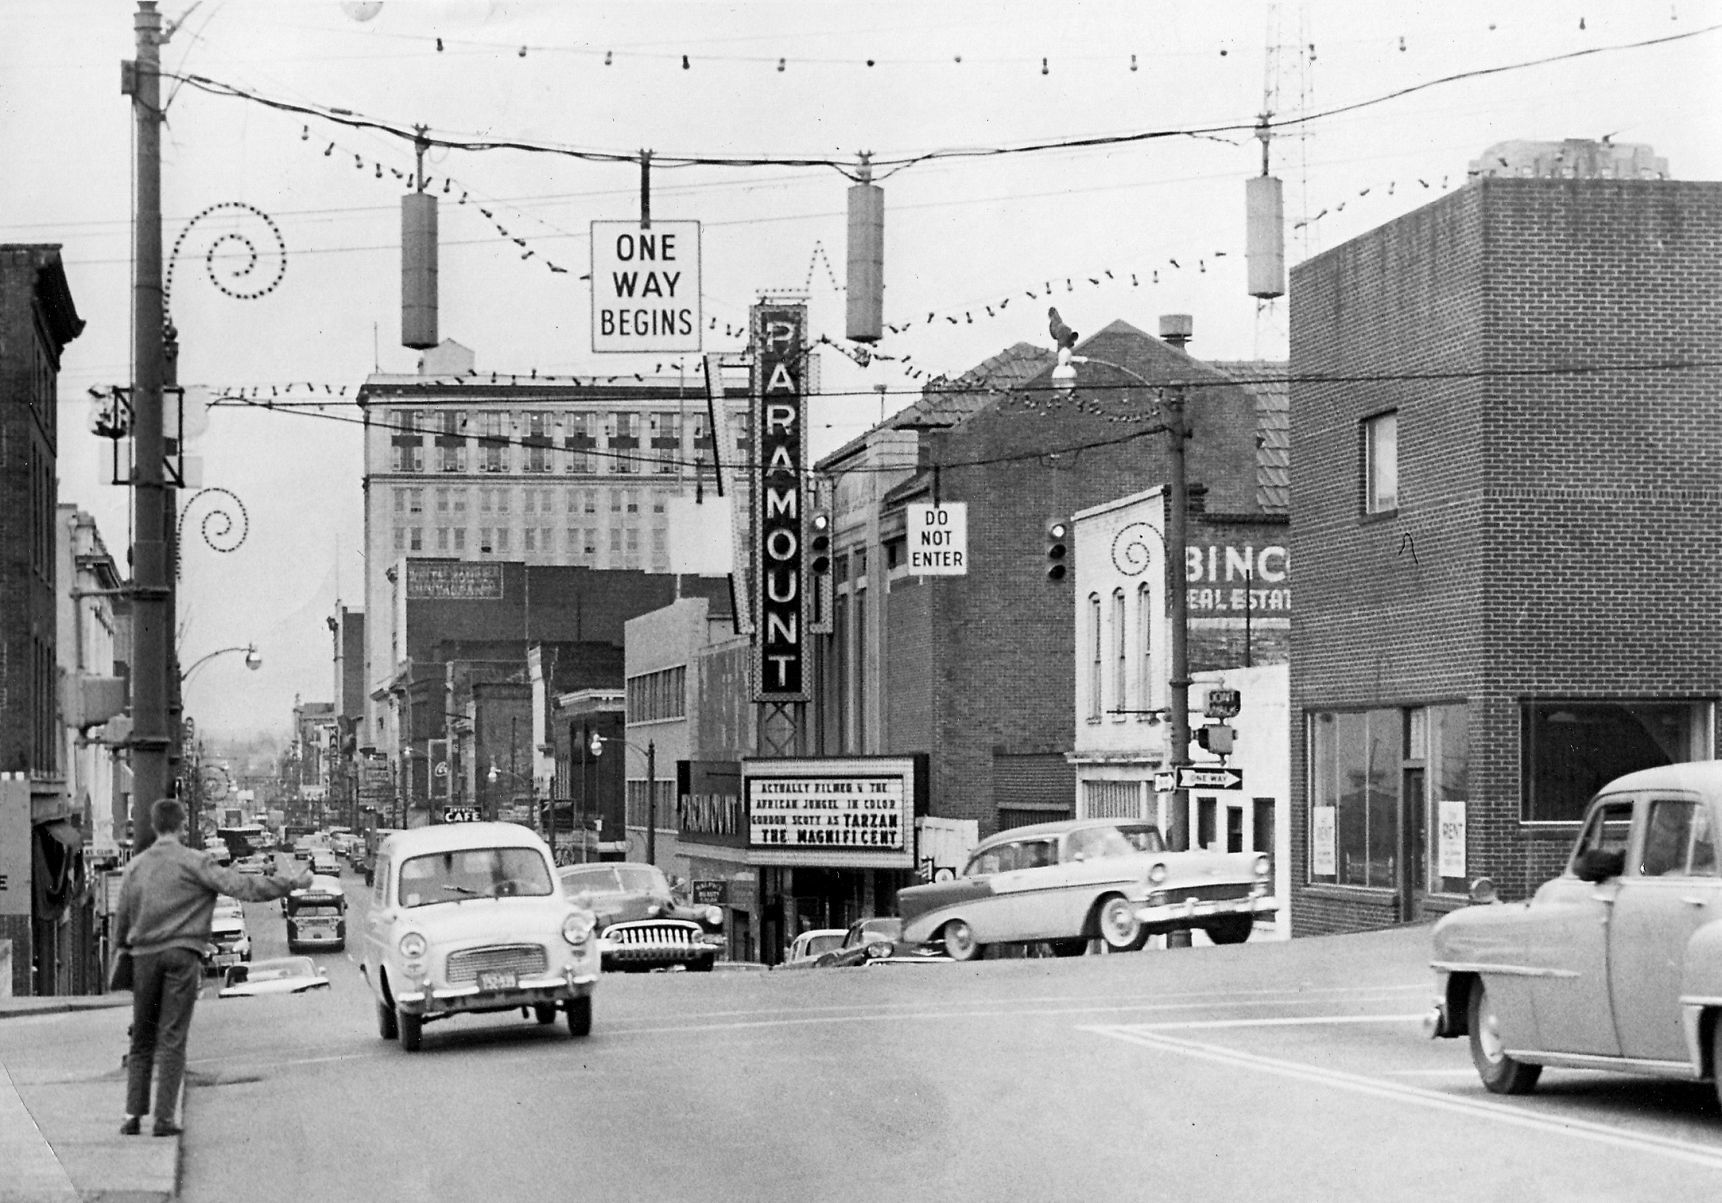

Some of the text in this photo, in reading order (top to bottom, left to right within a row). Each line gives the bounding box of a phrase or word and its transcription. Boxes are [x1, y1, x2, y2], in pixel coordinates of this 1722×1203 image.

[616, 233, 676, 261] ONE
[612, 271, 681, 298] WAY
[601, 308, 692, 336] BEGINS
[766, 321, 797, 687] PARAMOUNT
[925, 510, 948, 526] DO
[921, 530, 952, 546] NOT
[912, 551, 963, 567] ENTER
[1185, 545, 1291, 582] BINC
[1186, 588, 1228, 610] EAL
[761, 783, 809, 793] ACTUALLY
[870, 783, 888, 793] THE
[756, 799, 797, 809] AFRICAN
[847, 799, 859, 809] IN
[864, 799, 896, 809] COLOR
[445, 812, 481, 822] CAFE
[751, 813, 898, 828] GORDON SCOTT AS TARZAN
[761, 828, 897, 844] THE MAGNIFICENT
[1442, 822, 1464, 839] RENT
